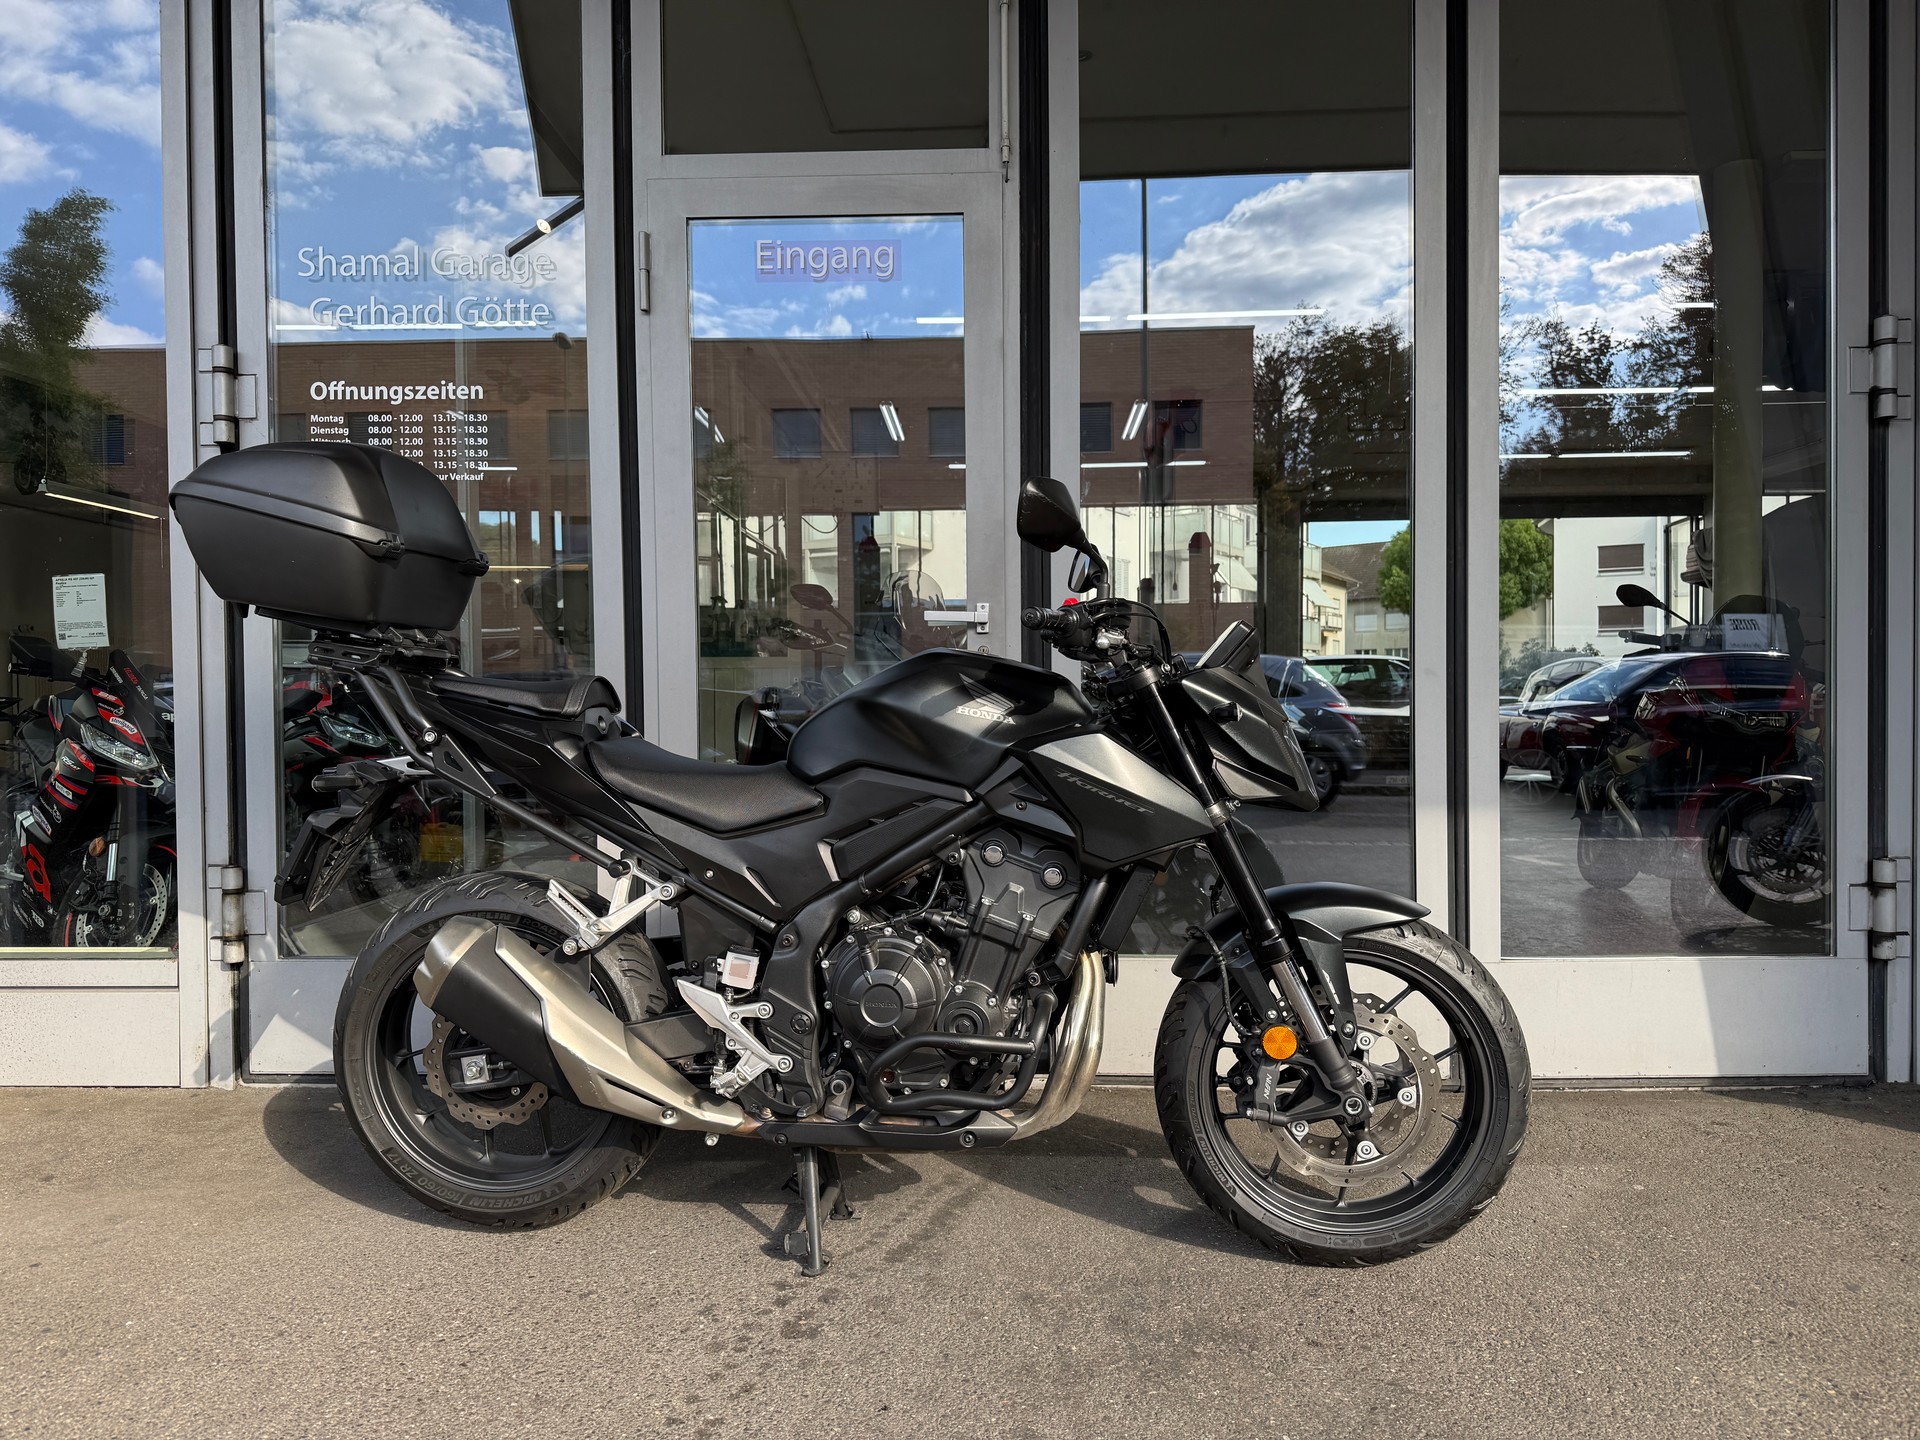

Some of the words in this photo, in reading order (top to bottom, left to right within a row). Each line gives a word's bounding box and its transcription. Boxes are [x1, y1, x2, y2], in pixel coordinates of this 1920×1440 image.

[756, 239, 894, 278] Eingang
[297, 245, 420, 278] Shamal
[430, 246, 552, 284] Garage
[308, 295, 444, 327] Gerhard
[455, 296, 550, 326] Götte
[310, 414, 344, 424] Montag
[367, 414, 392, 422] 08.00
[399, 414, 423, 422] 12.00
[432, 413, 457, 422] 13.15
[464, 413, 488, 422] 18.30
[310, 426, 349, 436] Dienstag
[367, 426, 392, 434] 08.00
[399, 426, 423, 434] 12.00
[432, 425, 457, 434] 13.15
[464, 425, 488, 434] 18.30
[367, 437, 392, 446] 08.00
[399, 437, 423, 446] 12.00
[432, 437, 457, 446] 13.15
[399, 449, 424, 457] 12.00
[433, 449, 457, 457] 13.15
[464, 449, 489, 457] 18.30
[433, 461, 457, 469] 13.15
[465, 461, 489, 469] 18.30
[449, 472, 484, 481] Verkauf
[955, 705, 1016, 725] HONDA
[1055, 768, 1154, 815] HORNET
[864, 1000, 899, 1009] HONDA
[385, 1150, 403, 1165] 17
[1200, 1139, 1227, 1183] MICHELIN
[399, 1164, 419, 1180] ZR
[416, 1177, 461, 1202] 160/60
[468, 1191, 543, 1209] MICHELIN
